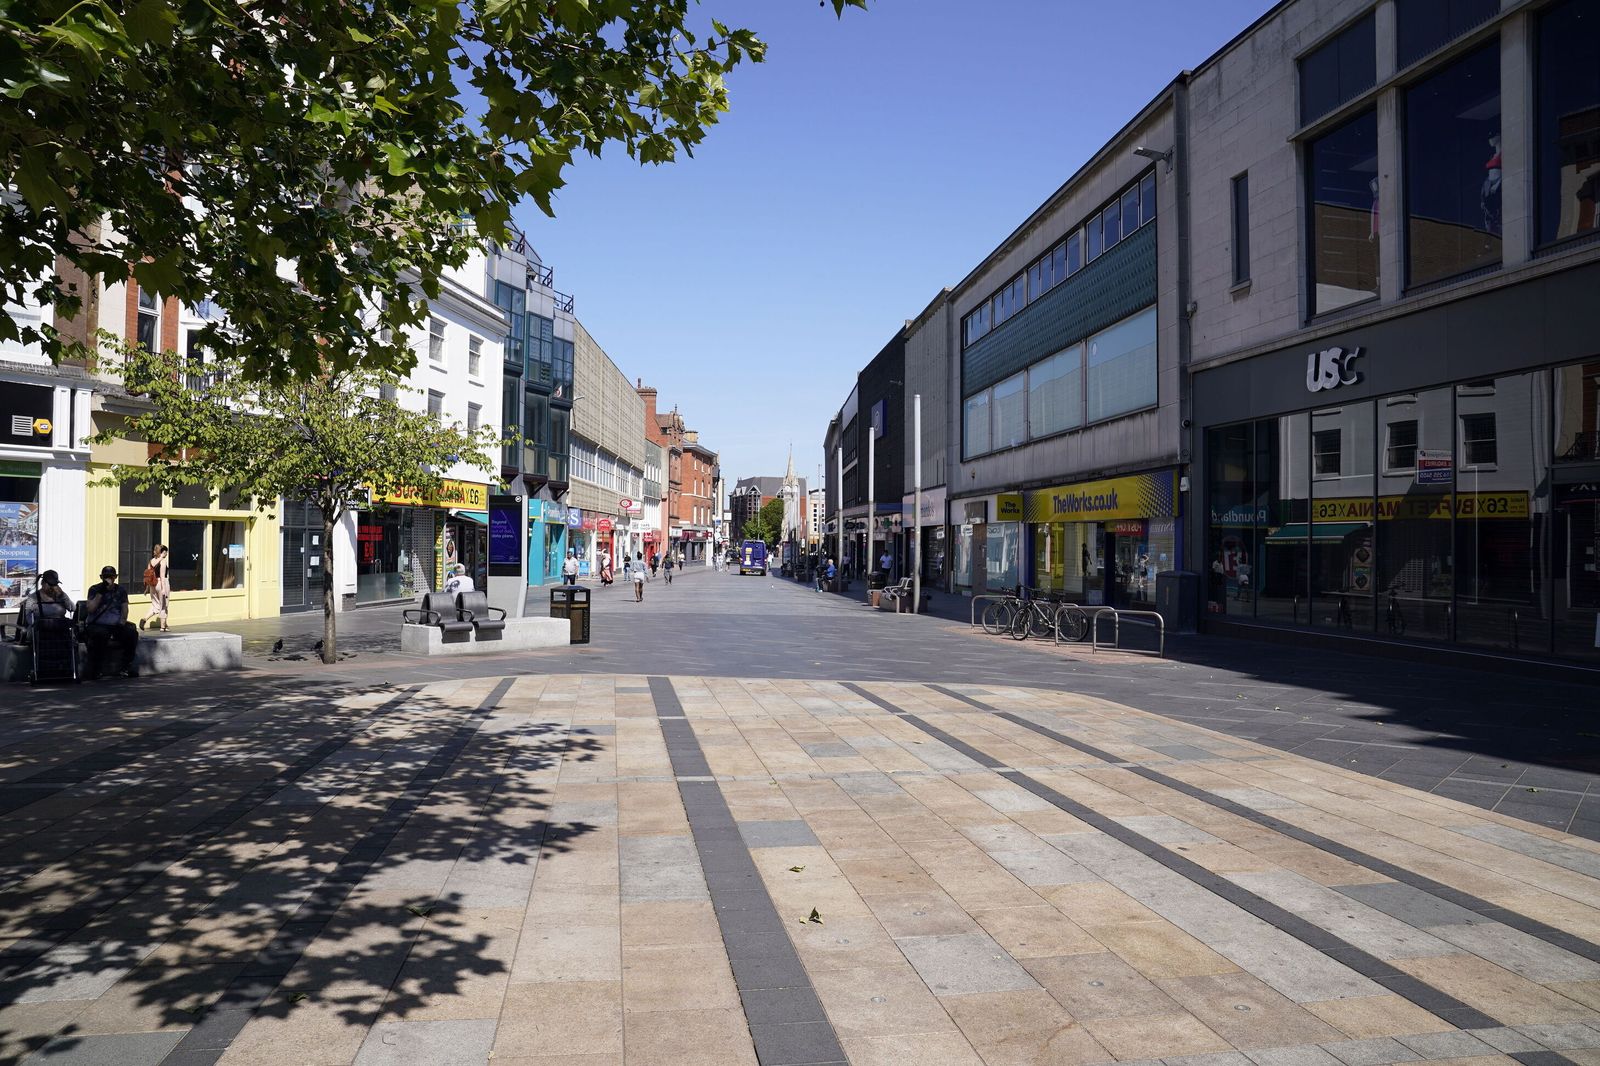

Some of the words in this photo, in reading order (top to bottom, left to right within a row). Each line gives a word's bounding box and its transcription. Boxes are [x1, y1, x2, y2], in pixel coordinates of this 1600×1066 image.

[1306, 346, 1360, 392] USC
[470, 488, 479, 505] £6
[1053, 488, 1118, 514] TheWorks.co.uk
[0, 549, 30, 557] Shopping
